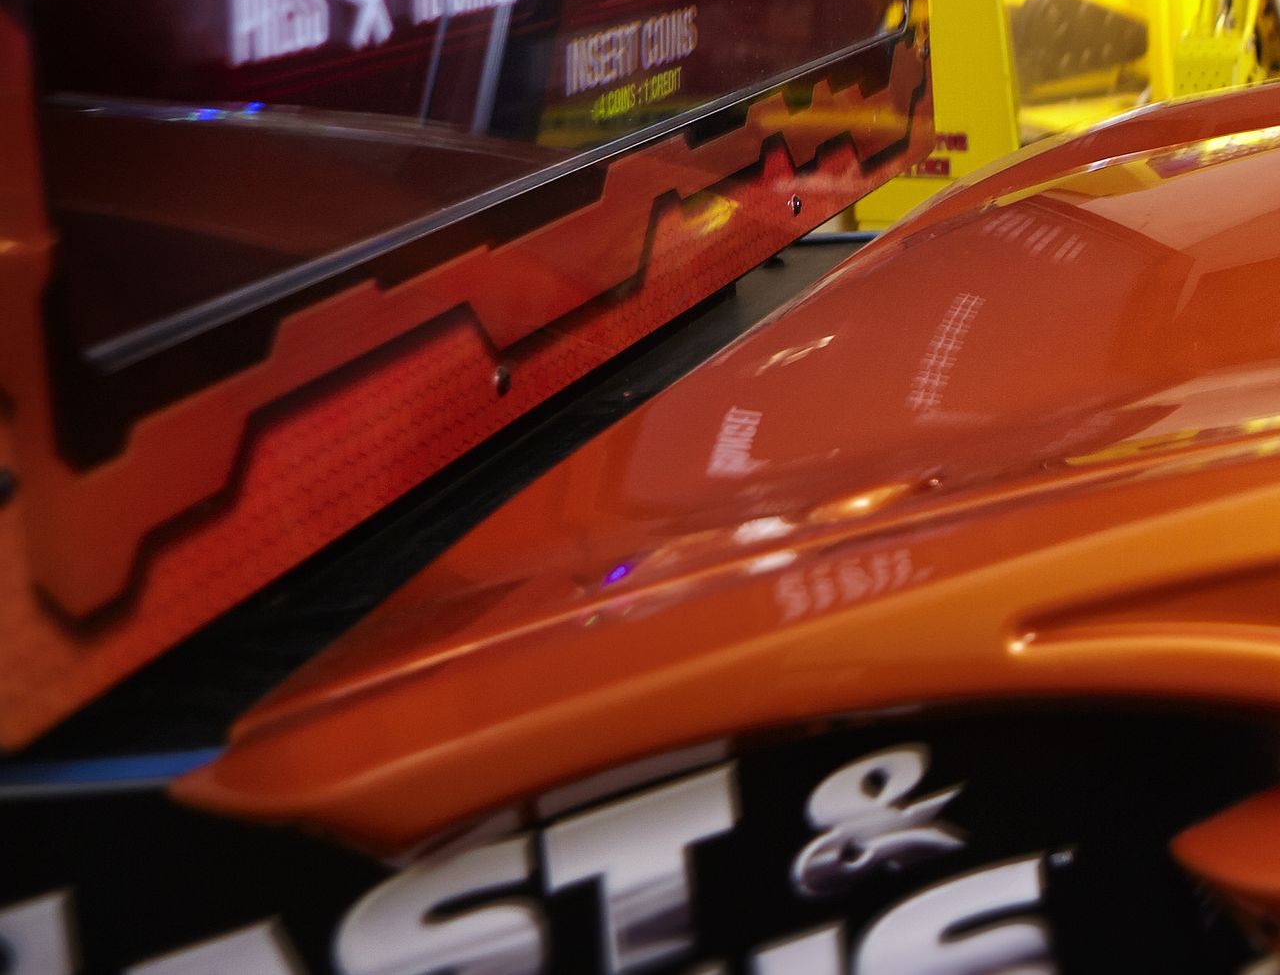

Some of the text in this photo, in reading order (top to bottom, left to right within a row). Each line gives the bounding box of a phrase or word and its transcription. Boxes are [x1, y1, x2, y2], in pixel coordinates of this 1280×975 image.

[565, 4, 698, 98] INSERT COINS
[651, 66, 682, 103] CREDIT
